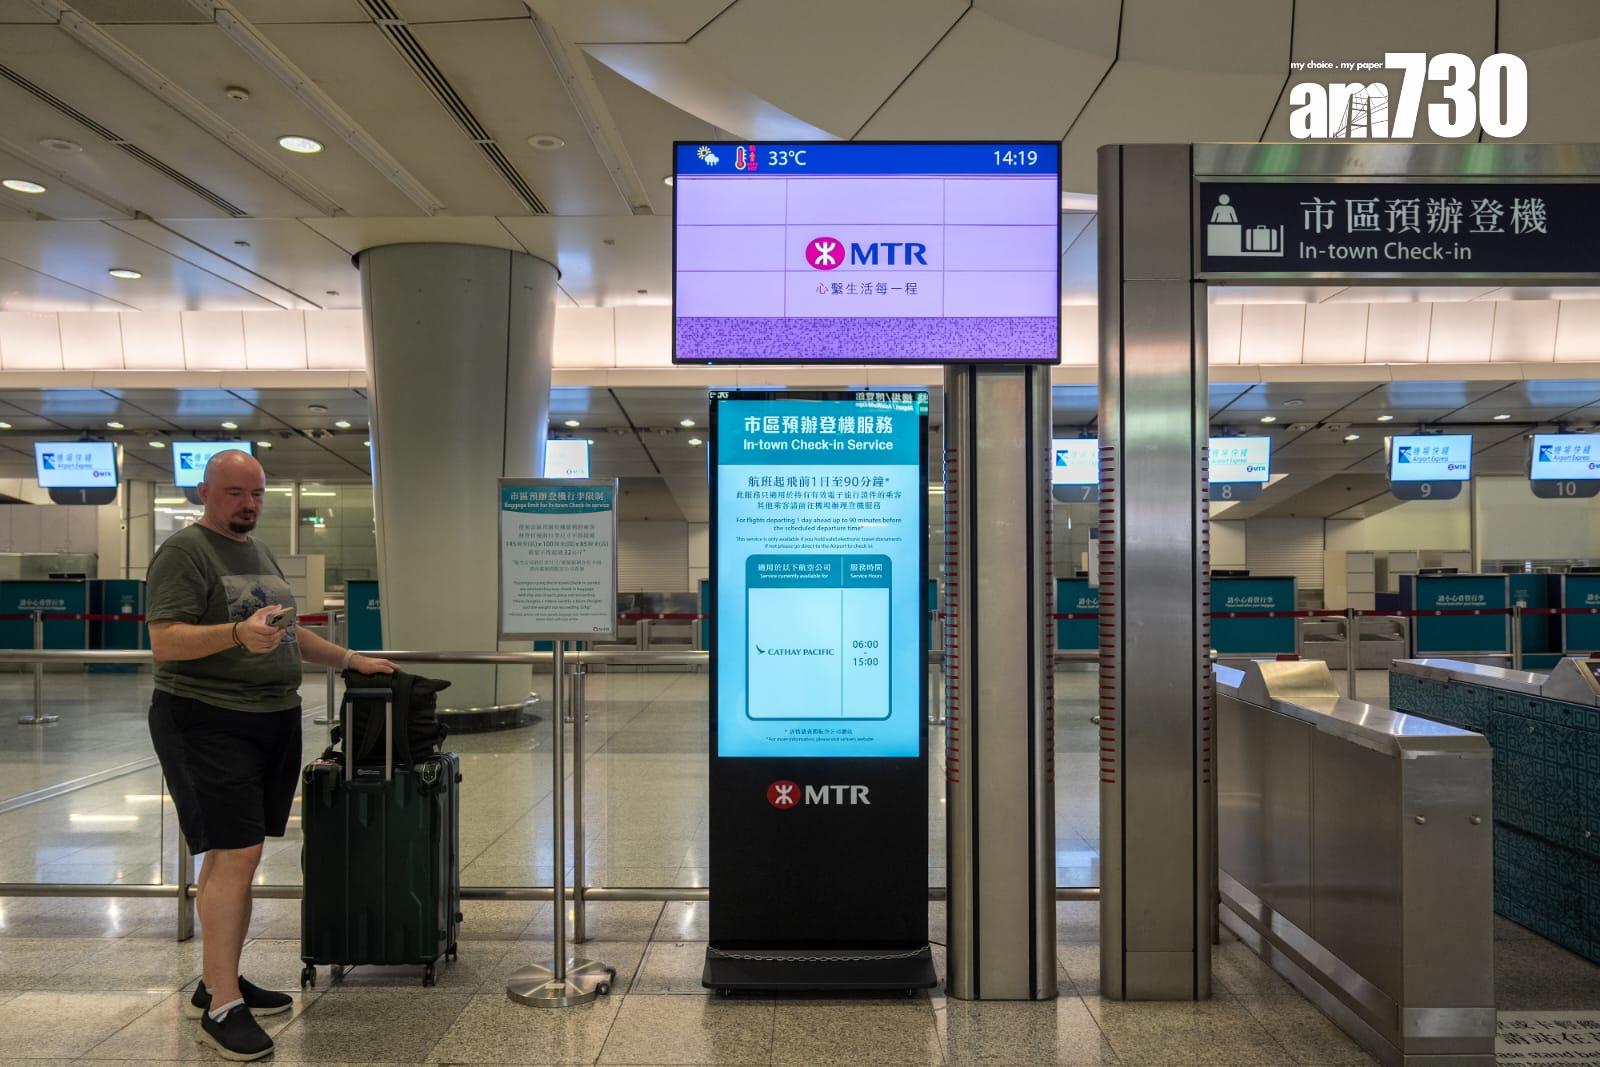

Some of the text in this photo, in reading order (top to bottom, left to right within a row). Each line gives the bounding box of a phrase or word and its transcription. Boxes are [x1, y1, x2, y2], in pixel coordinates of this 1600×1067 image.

[994, 150, 1038, 166] 14:19
[1300, 197, 1548, 234] 市區預辦登機
[851, 242, 928, 265] MTR
[1300, 242, 1472, 260] In-town Check-in
[816, 282, 919, 296] 心繫生活每一程
[744, 416, 893, 434] 市區預辦登機服務
[743, 439, 894, 450] In-town Check-in Service
[1081, 486, 1091, 501] 7
[1222, 485, 1232, 499] 8
[1421, 483, 1431, 497] 9
[1556, 481, 1577, 496] 10
[80, 489, 86, 503] 1
[850, 563, 883, 572] 服務時間
[852, 640, 879, 649] 06:00
[853, 658, 879, 666] 15:00
[805, 785, 871, 805] MTR
